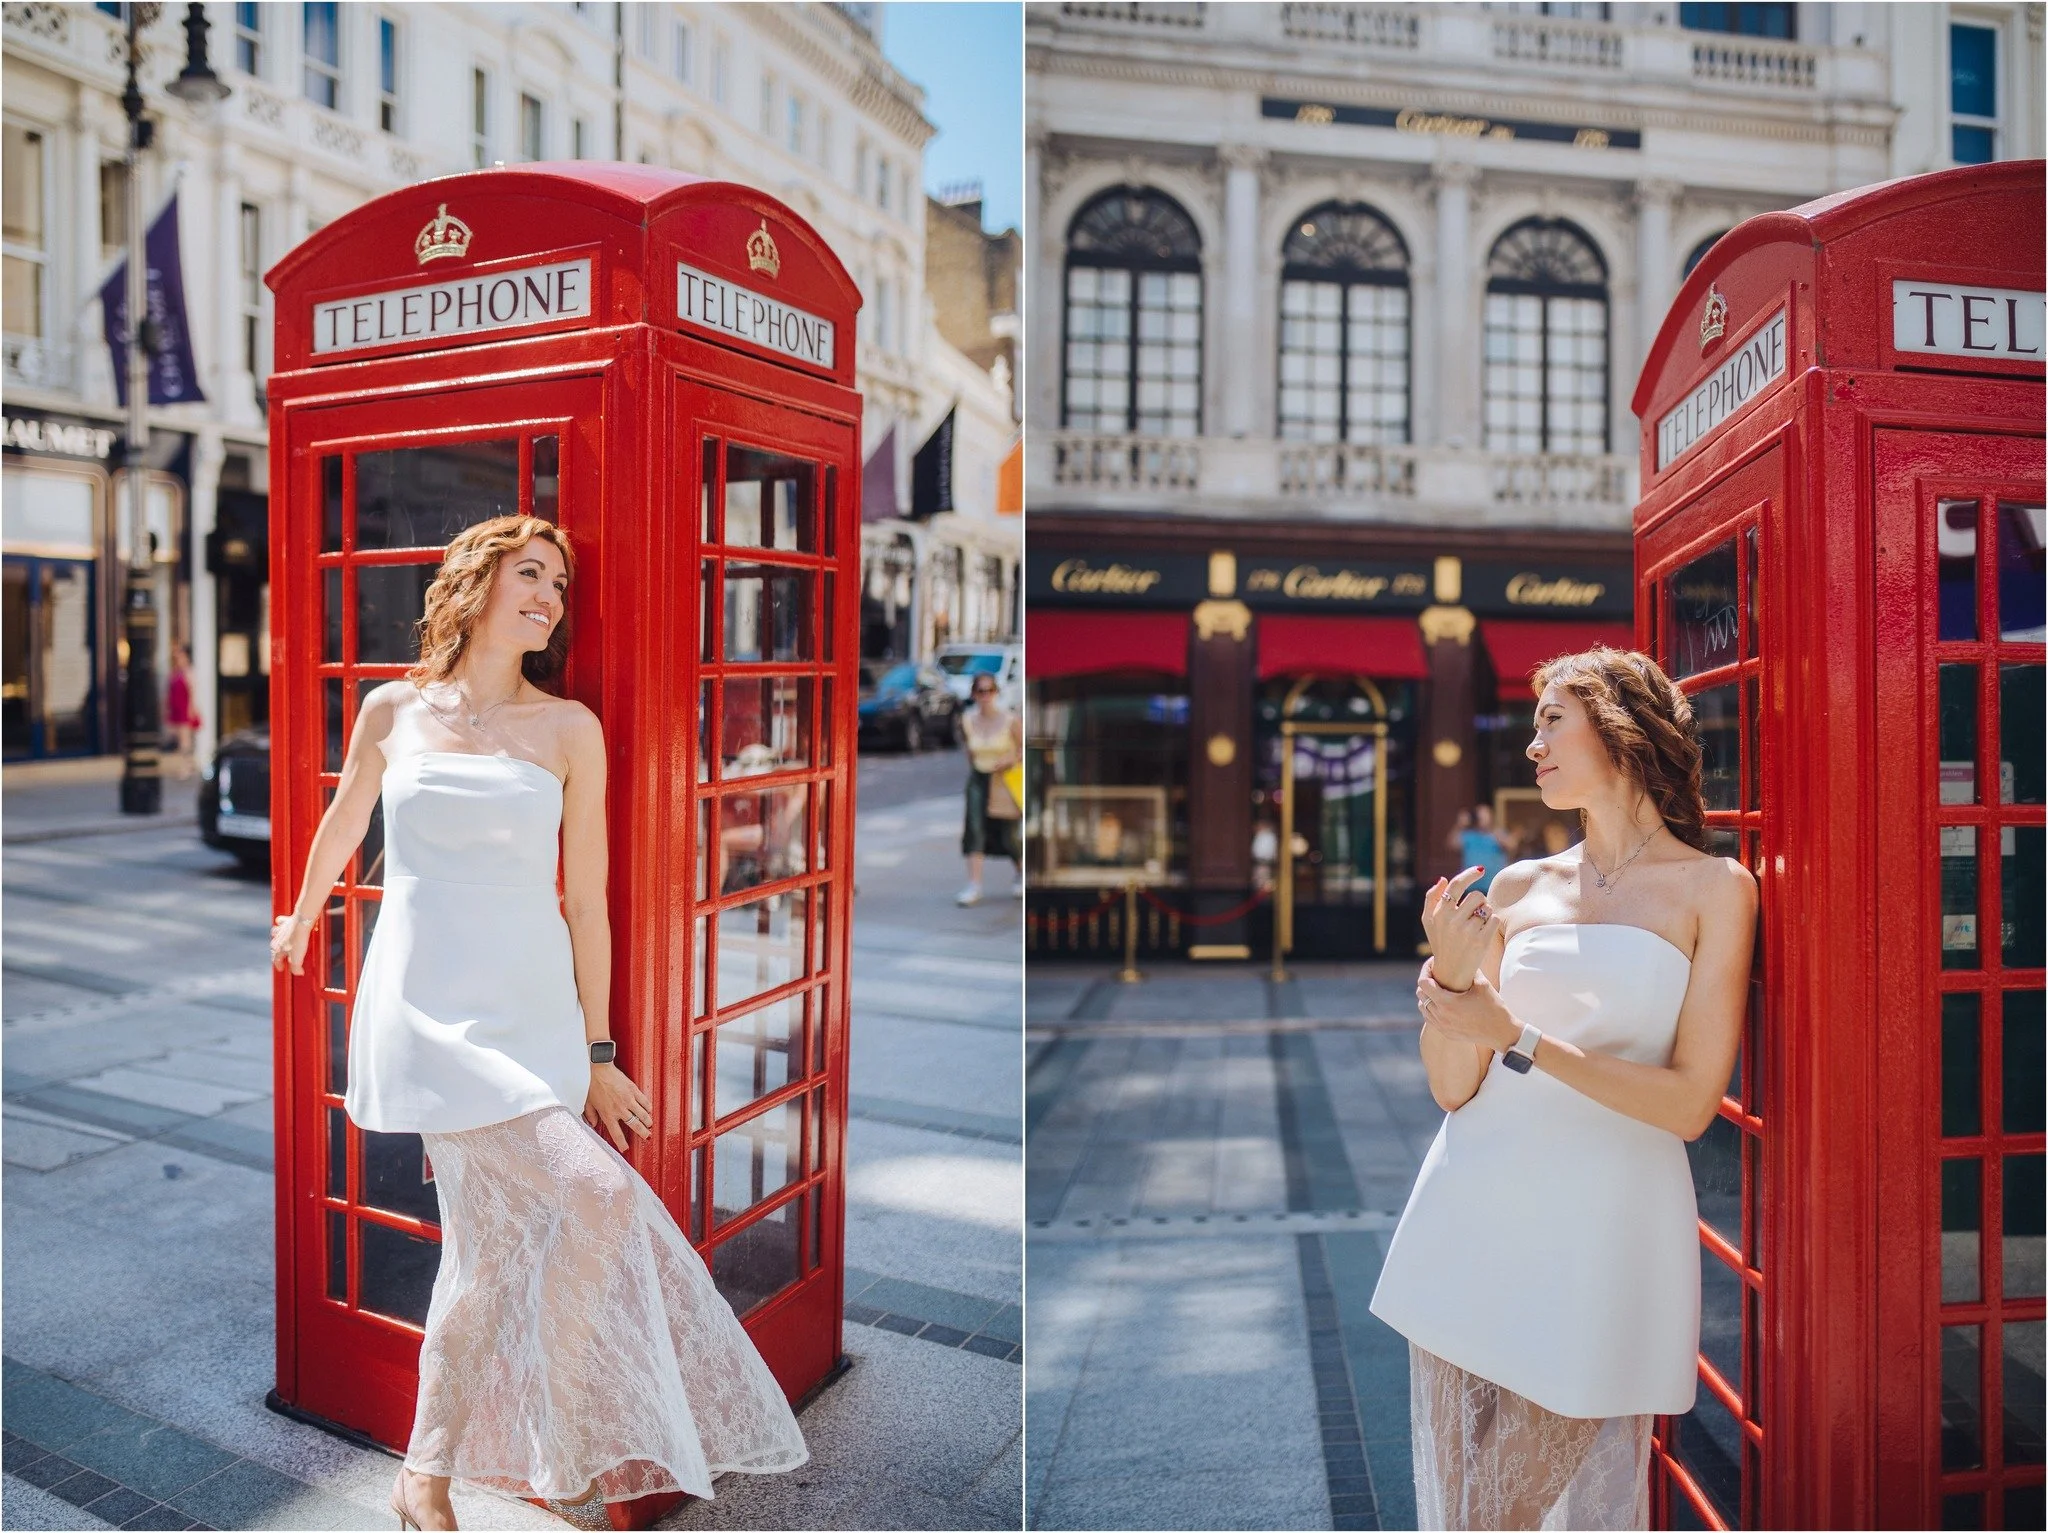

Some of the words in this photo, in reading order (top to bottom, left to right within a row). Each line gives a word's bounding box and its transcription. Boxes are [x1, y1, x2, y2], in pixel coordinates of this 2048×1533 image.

[325, 268, 580, 346] TELEPHONE
[682, 272, 829, 364] TELEPHONE
[1909, 292, 2046, 354] TEL
[1664, 318, 1784, 464] TELEPHONE
[1051, 558, 1160, 594] Cartier
[1283, 564, 1389, 600] Cartier
[1506, 571, 1605, 607] Cartier
